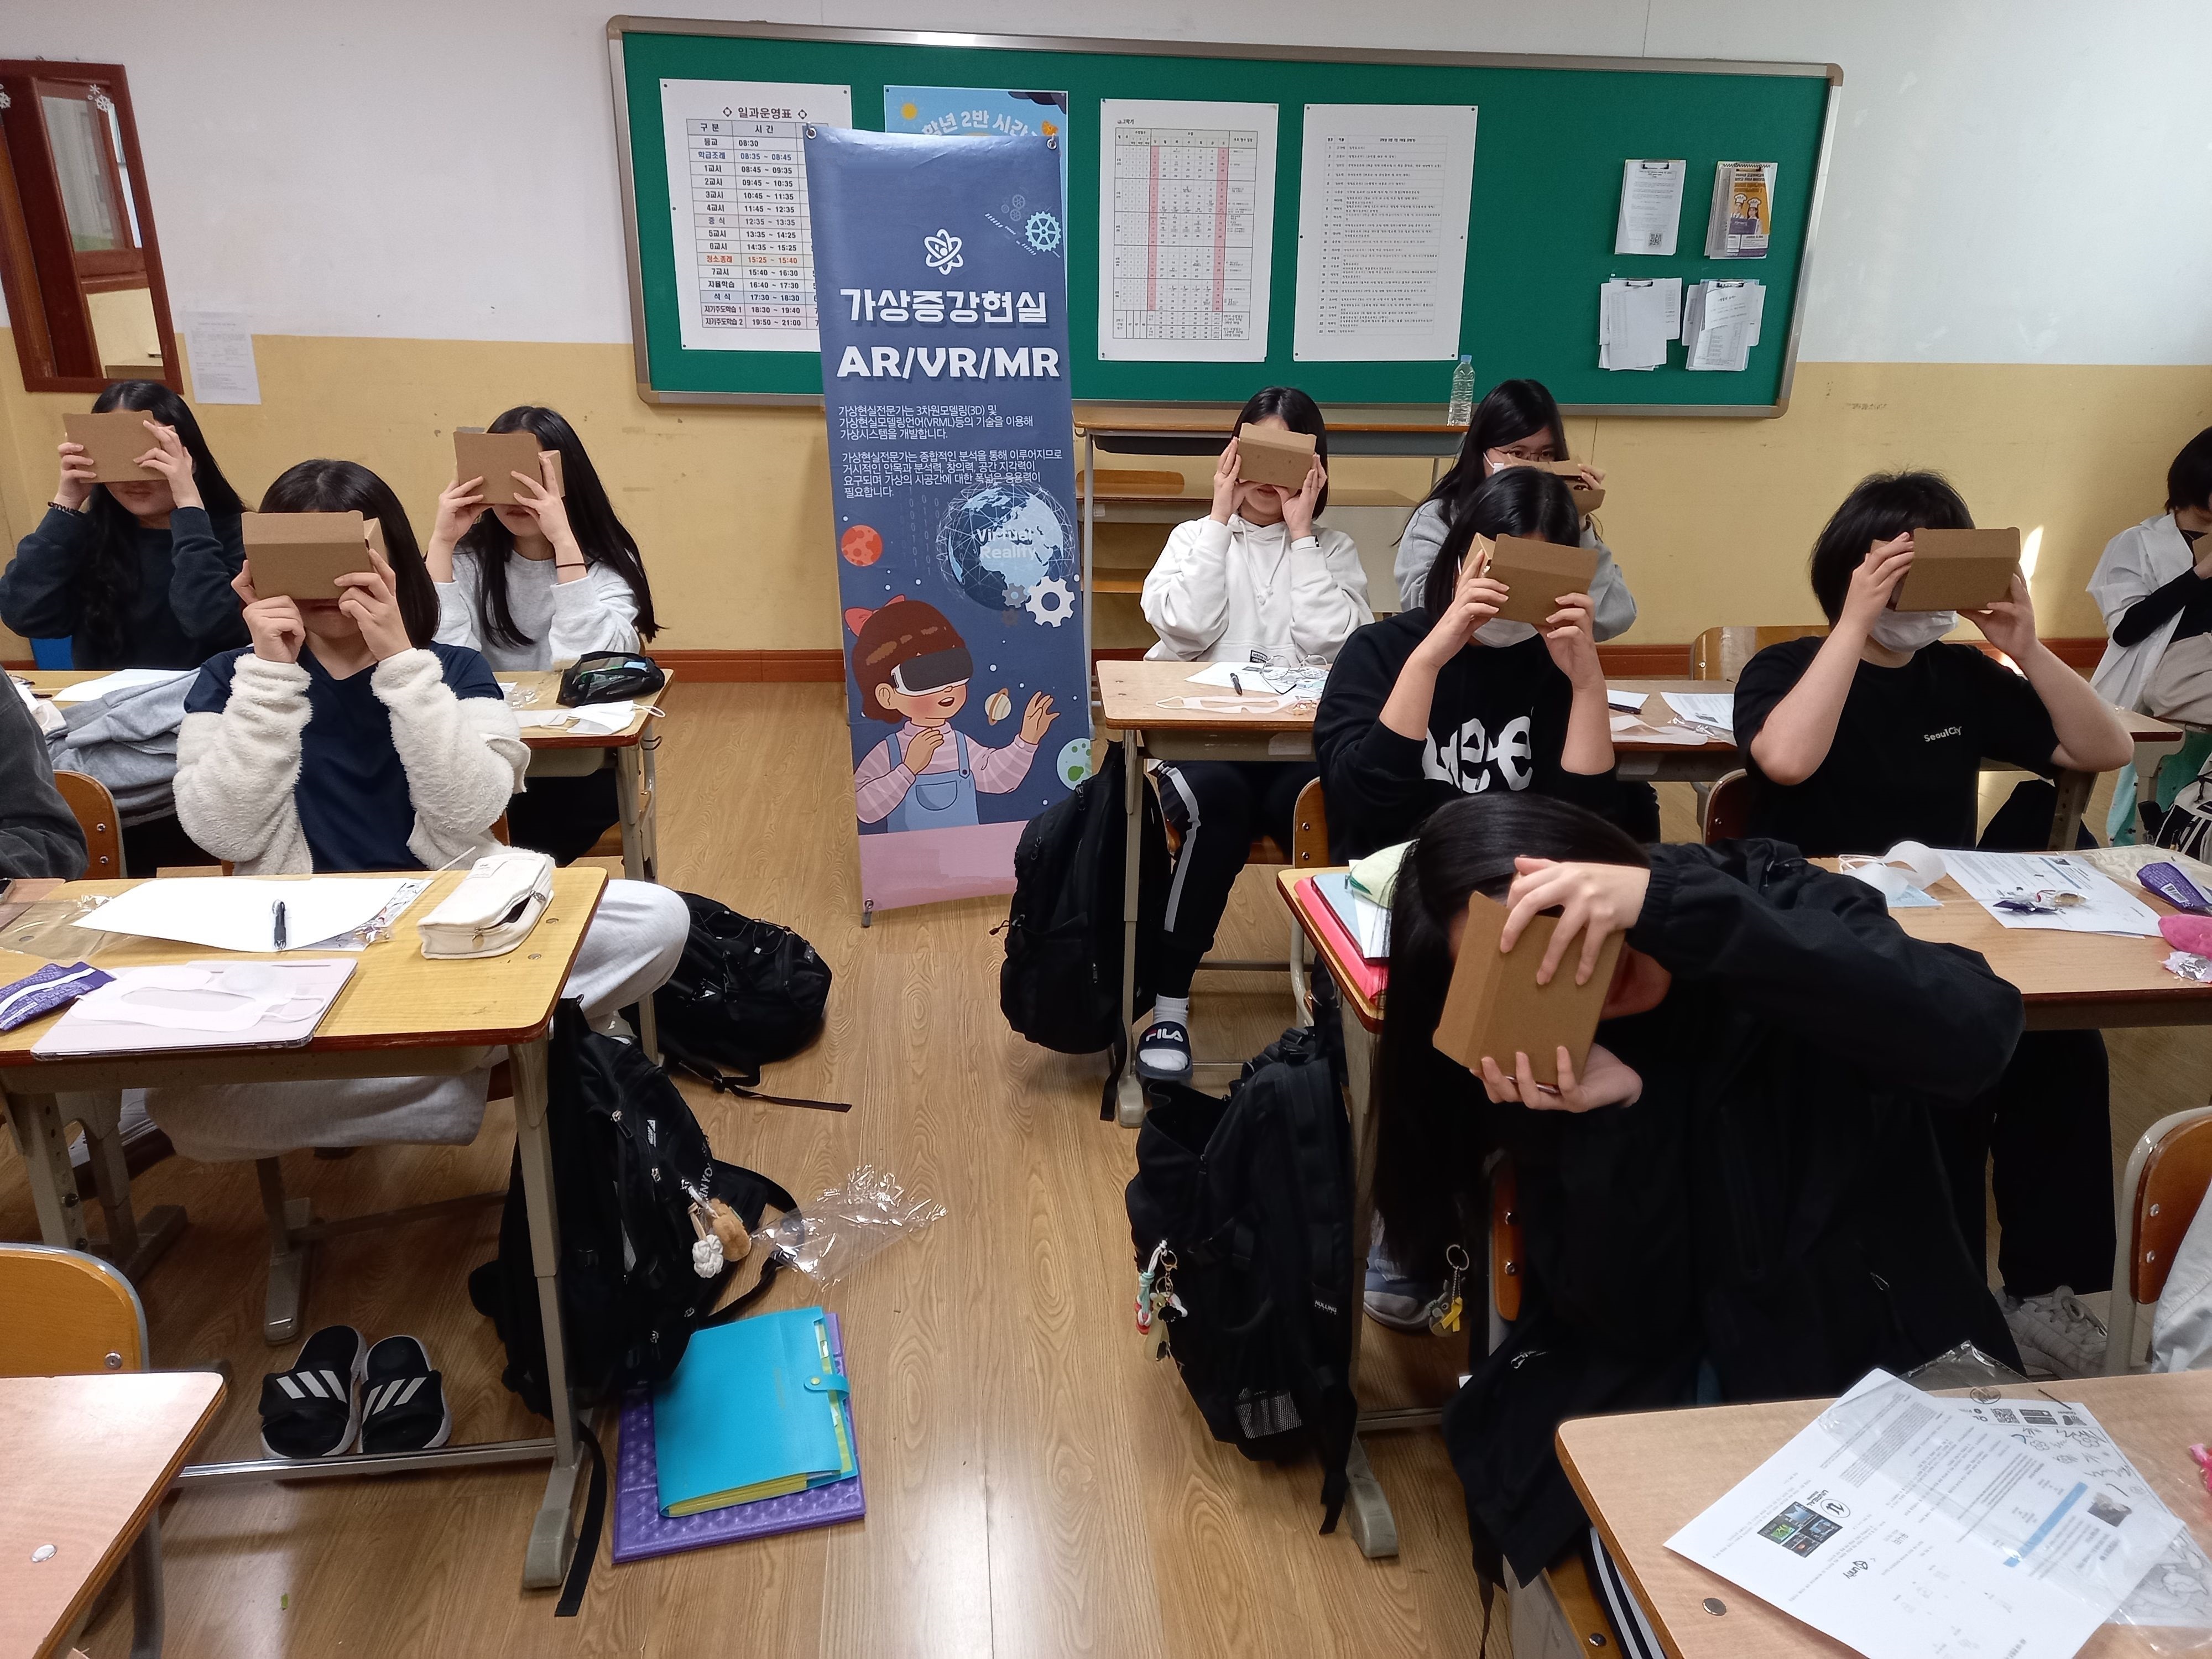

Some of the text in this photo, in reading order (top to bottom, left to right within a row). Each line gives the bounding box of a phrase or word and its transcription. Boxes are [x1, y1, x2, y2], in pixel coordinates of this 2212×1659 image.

[738, 107, 791, 119] 일과운영표
[961, 110, 989, 128] 2반
[993, 113, 1037, 136] 시간
[840, 289, 1047, 323] 가상증강현실
[837, 346, 1060, 379] AR/VR/MR
[838, 405, 997, 416] 가상현실전문가는 3차원모델링(3D) 및
[839, 416, 1033, 429] 가상현실모델링언어(VRML)등의 기술을 이용해
[841, 428, 948, 440] 가상시스템을 개발합니다.
[842, 449, 1062, 463] 가상현실전문가는 종합적인 분석을 통해 이루어지므로
[843, 461, 1035, 474] 거시적인 안목과 분석력, 창의력, 공간 지각력이
[844, 476, 881, 486] 요구되며
[885, 474, 912, 486] 가상의
[915, 474, 951, 486] 시공간에
[955, 473, 972, 484] 대한
[845, 486, 894, 498] 필요합니다.
[977, 528, 1033, 542] Virtual
[980, 545, 1036, 560] Reality
[1146, 1028, 1183, 1042] FILA
[1807, 1489, 1829, 1506] UNREAL
[1843, 1566, 1860, 1579] unity
